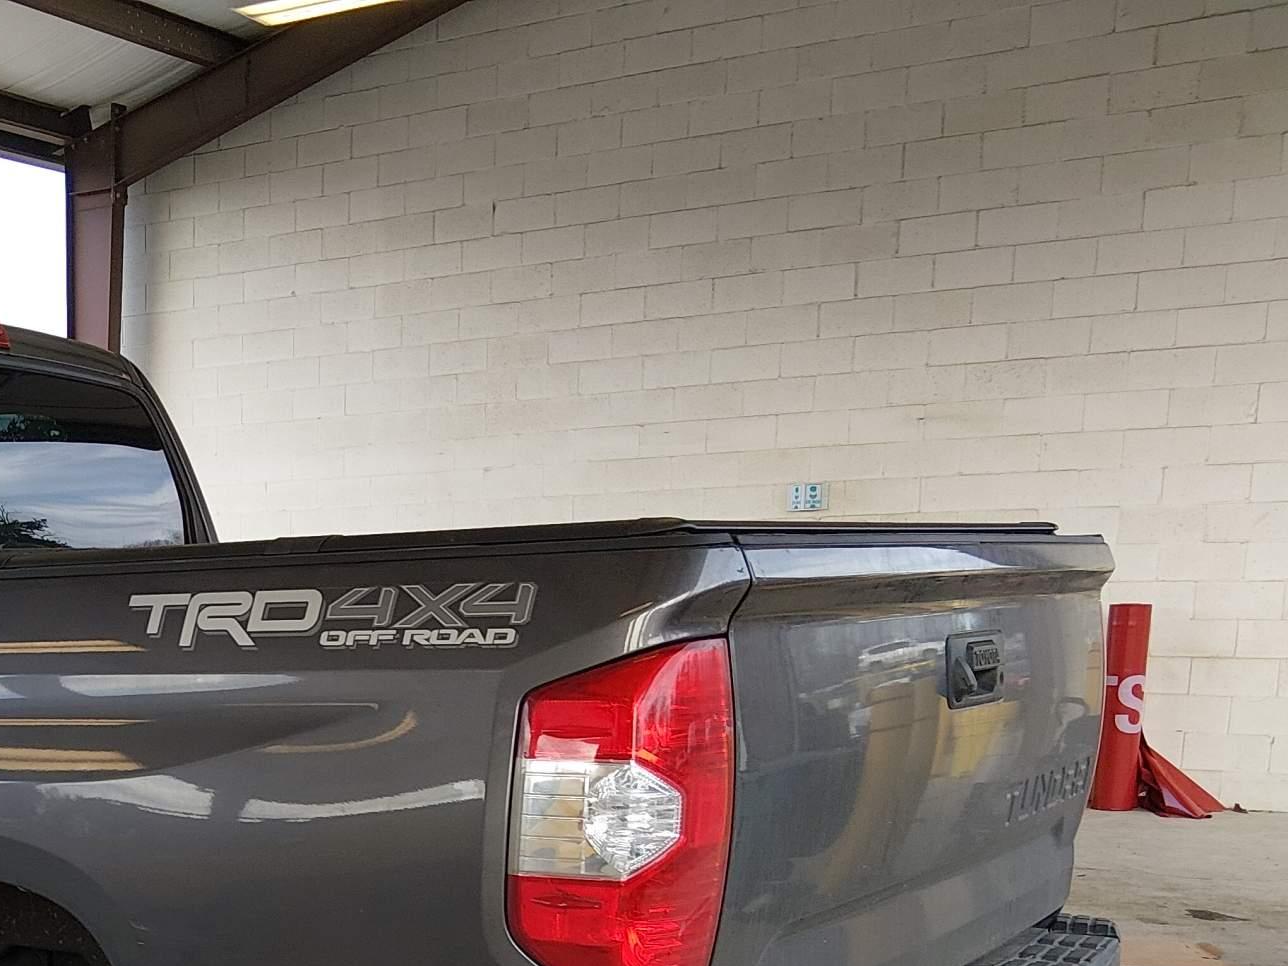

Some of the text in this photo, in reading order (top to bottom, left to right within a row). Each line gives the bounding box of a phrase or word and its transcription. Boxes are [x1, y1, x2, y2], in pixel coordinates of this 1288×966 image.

[129, 582, 539, 648] TRD 4X4
[319, 628, 519, 649] OFF ROAD
